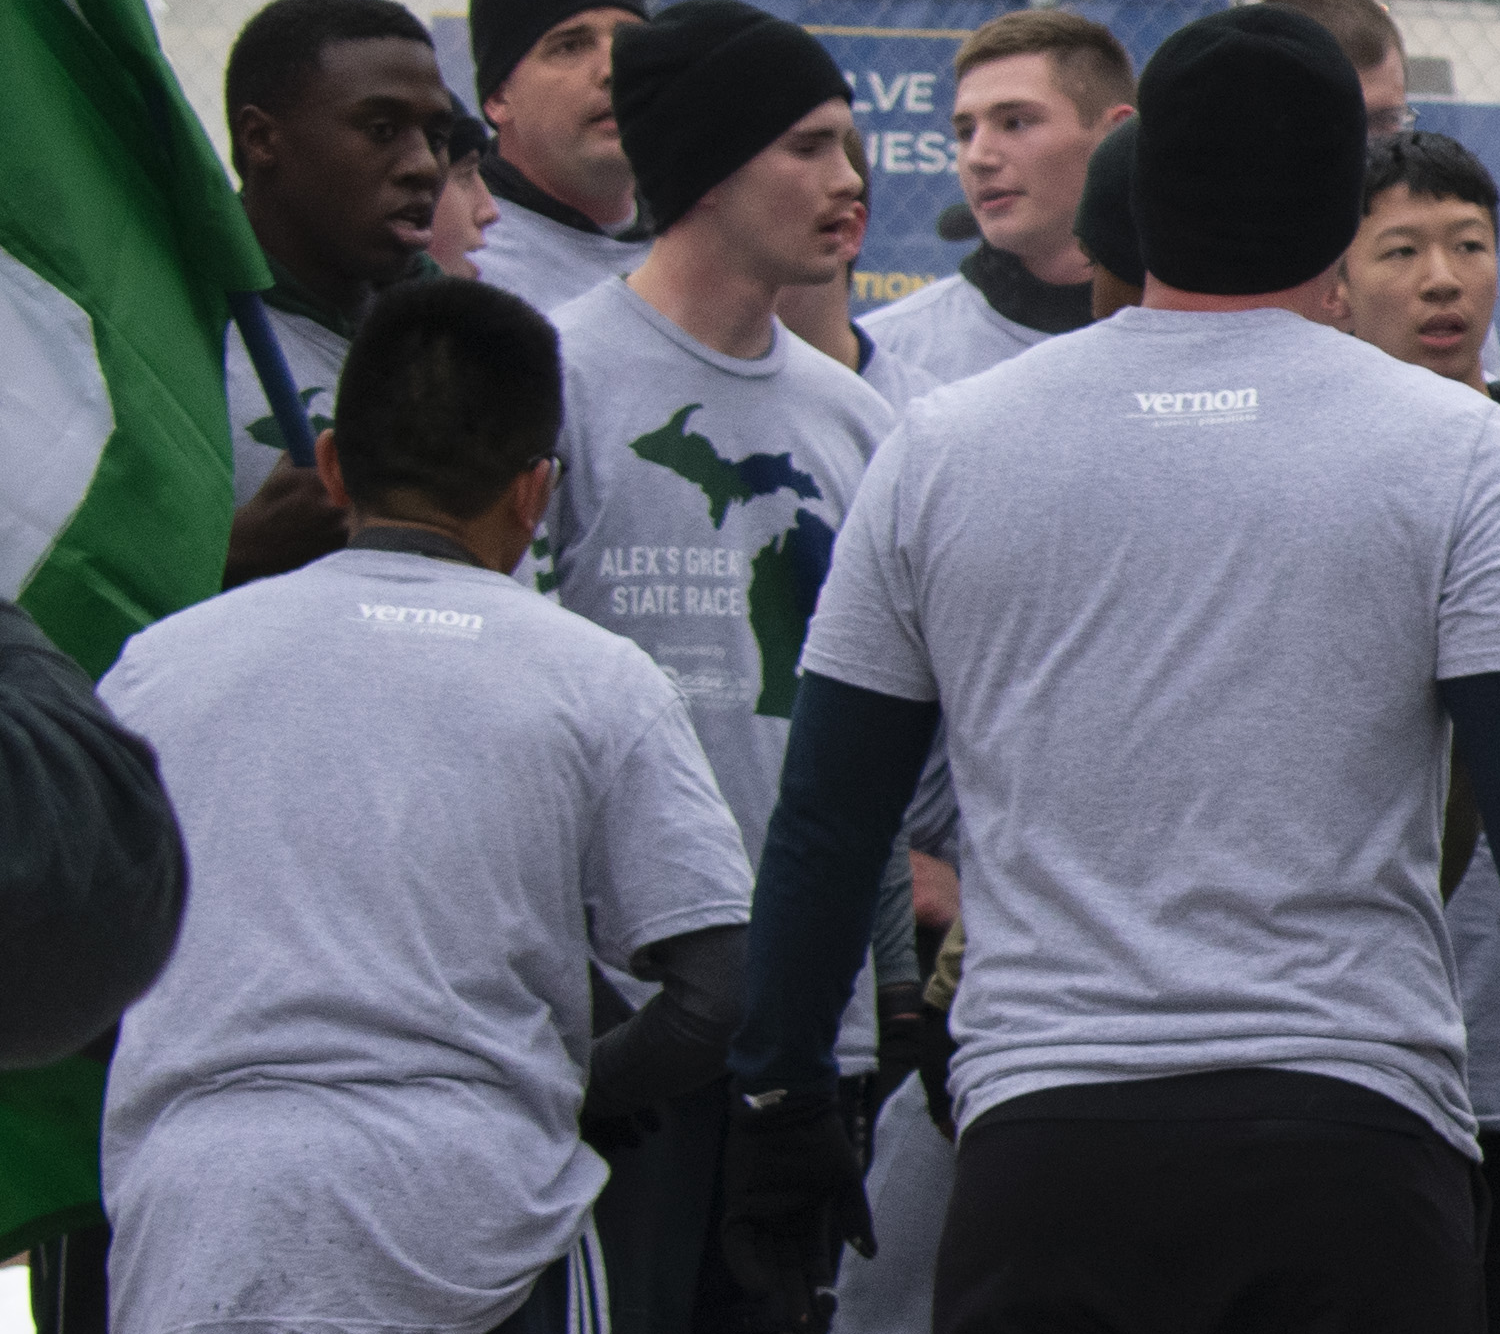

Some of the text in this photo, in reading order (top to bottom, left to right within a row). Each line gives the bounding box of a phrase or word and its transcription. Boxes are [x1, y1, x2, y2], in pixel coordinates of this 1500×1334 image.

[1134, 387, 1260, 413] vernon
[600, 546, 681, 577] ALEX'S
[611, 585, 742, 616] STATE RACE
[356, 602, 483, 629] vernon
